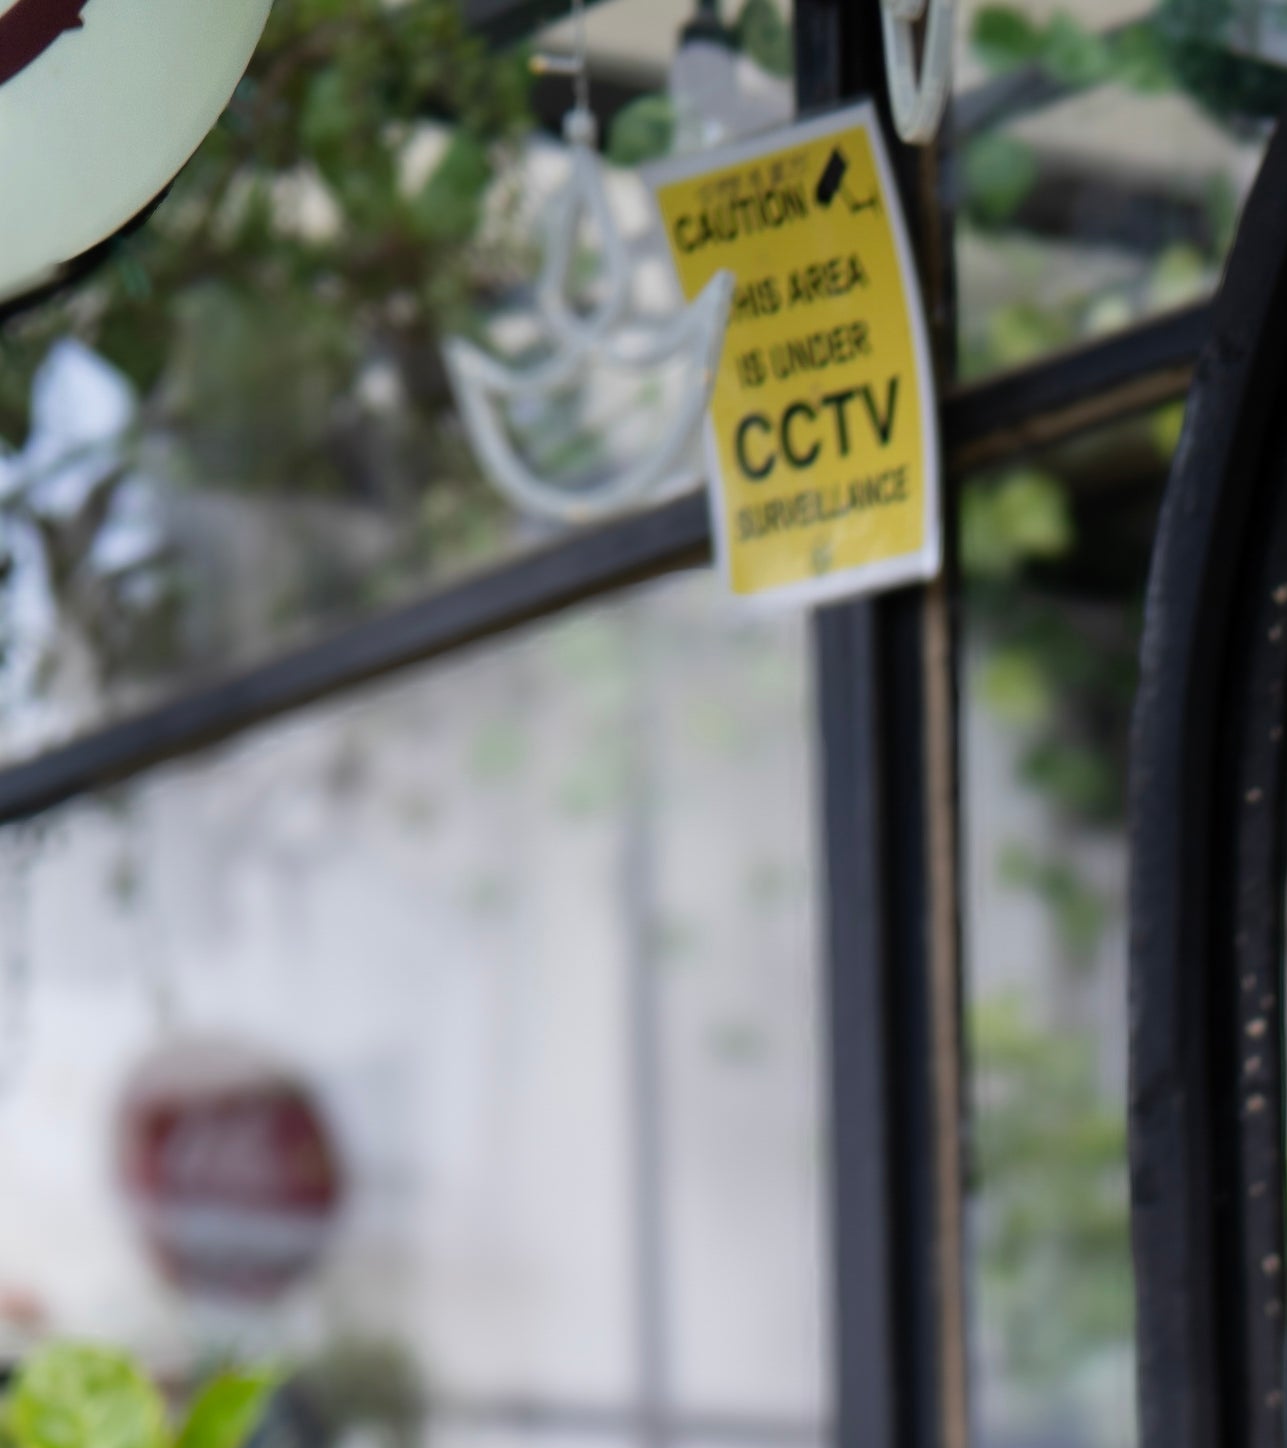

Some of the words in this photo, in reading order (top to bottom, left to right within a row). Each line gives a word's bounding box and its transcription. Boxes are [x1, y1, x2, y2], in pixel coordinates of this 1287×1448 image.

[673, 186, 808, 255] CAUTION
[731, 273, 781, 321] HIS
[788, 254, 869, 306] AREA
[737, 345, 766, 389] IS
[770, 320, 873, 380] UNDER
[734, 375, 900, 481] CCTV
[736, 464, 910, 543] SURVEILLANCE
